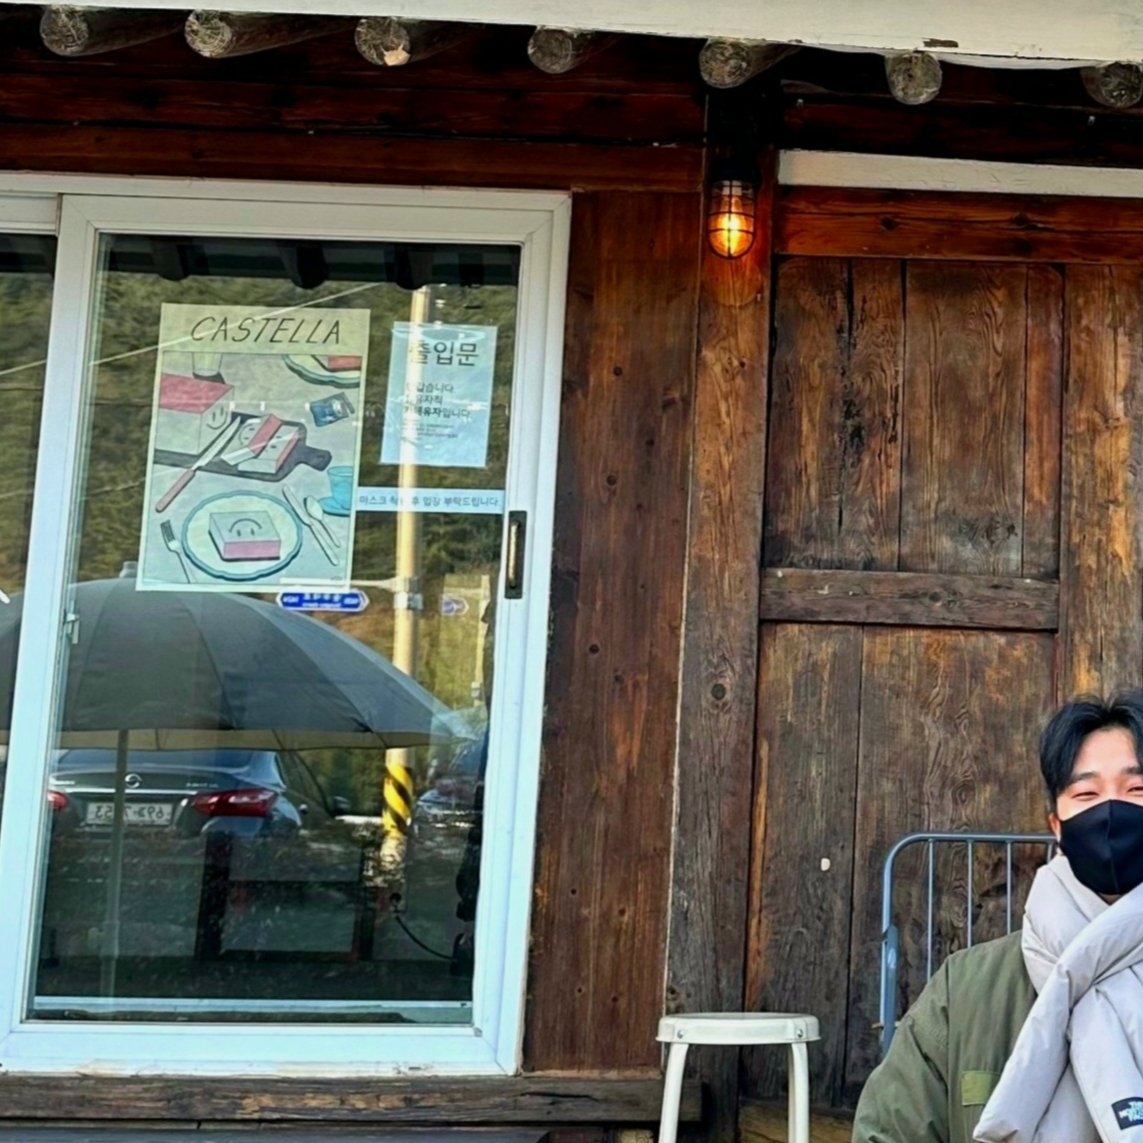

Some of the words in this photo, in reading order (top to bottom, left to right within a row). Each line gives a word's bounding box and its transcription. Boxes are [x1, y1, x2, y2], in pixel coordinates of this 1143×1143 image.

[189, 315, 342, 345] CASTELLA
[409, 340, 479, 367] 출입문
[359, 495, 387, 506] 마스크
[422, 496, 442, 507] 입장
